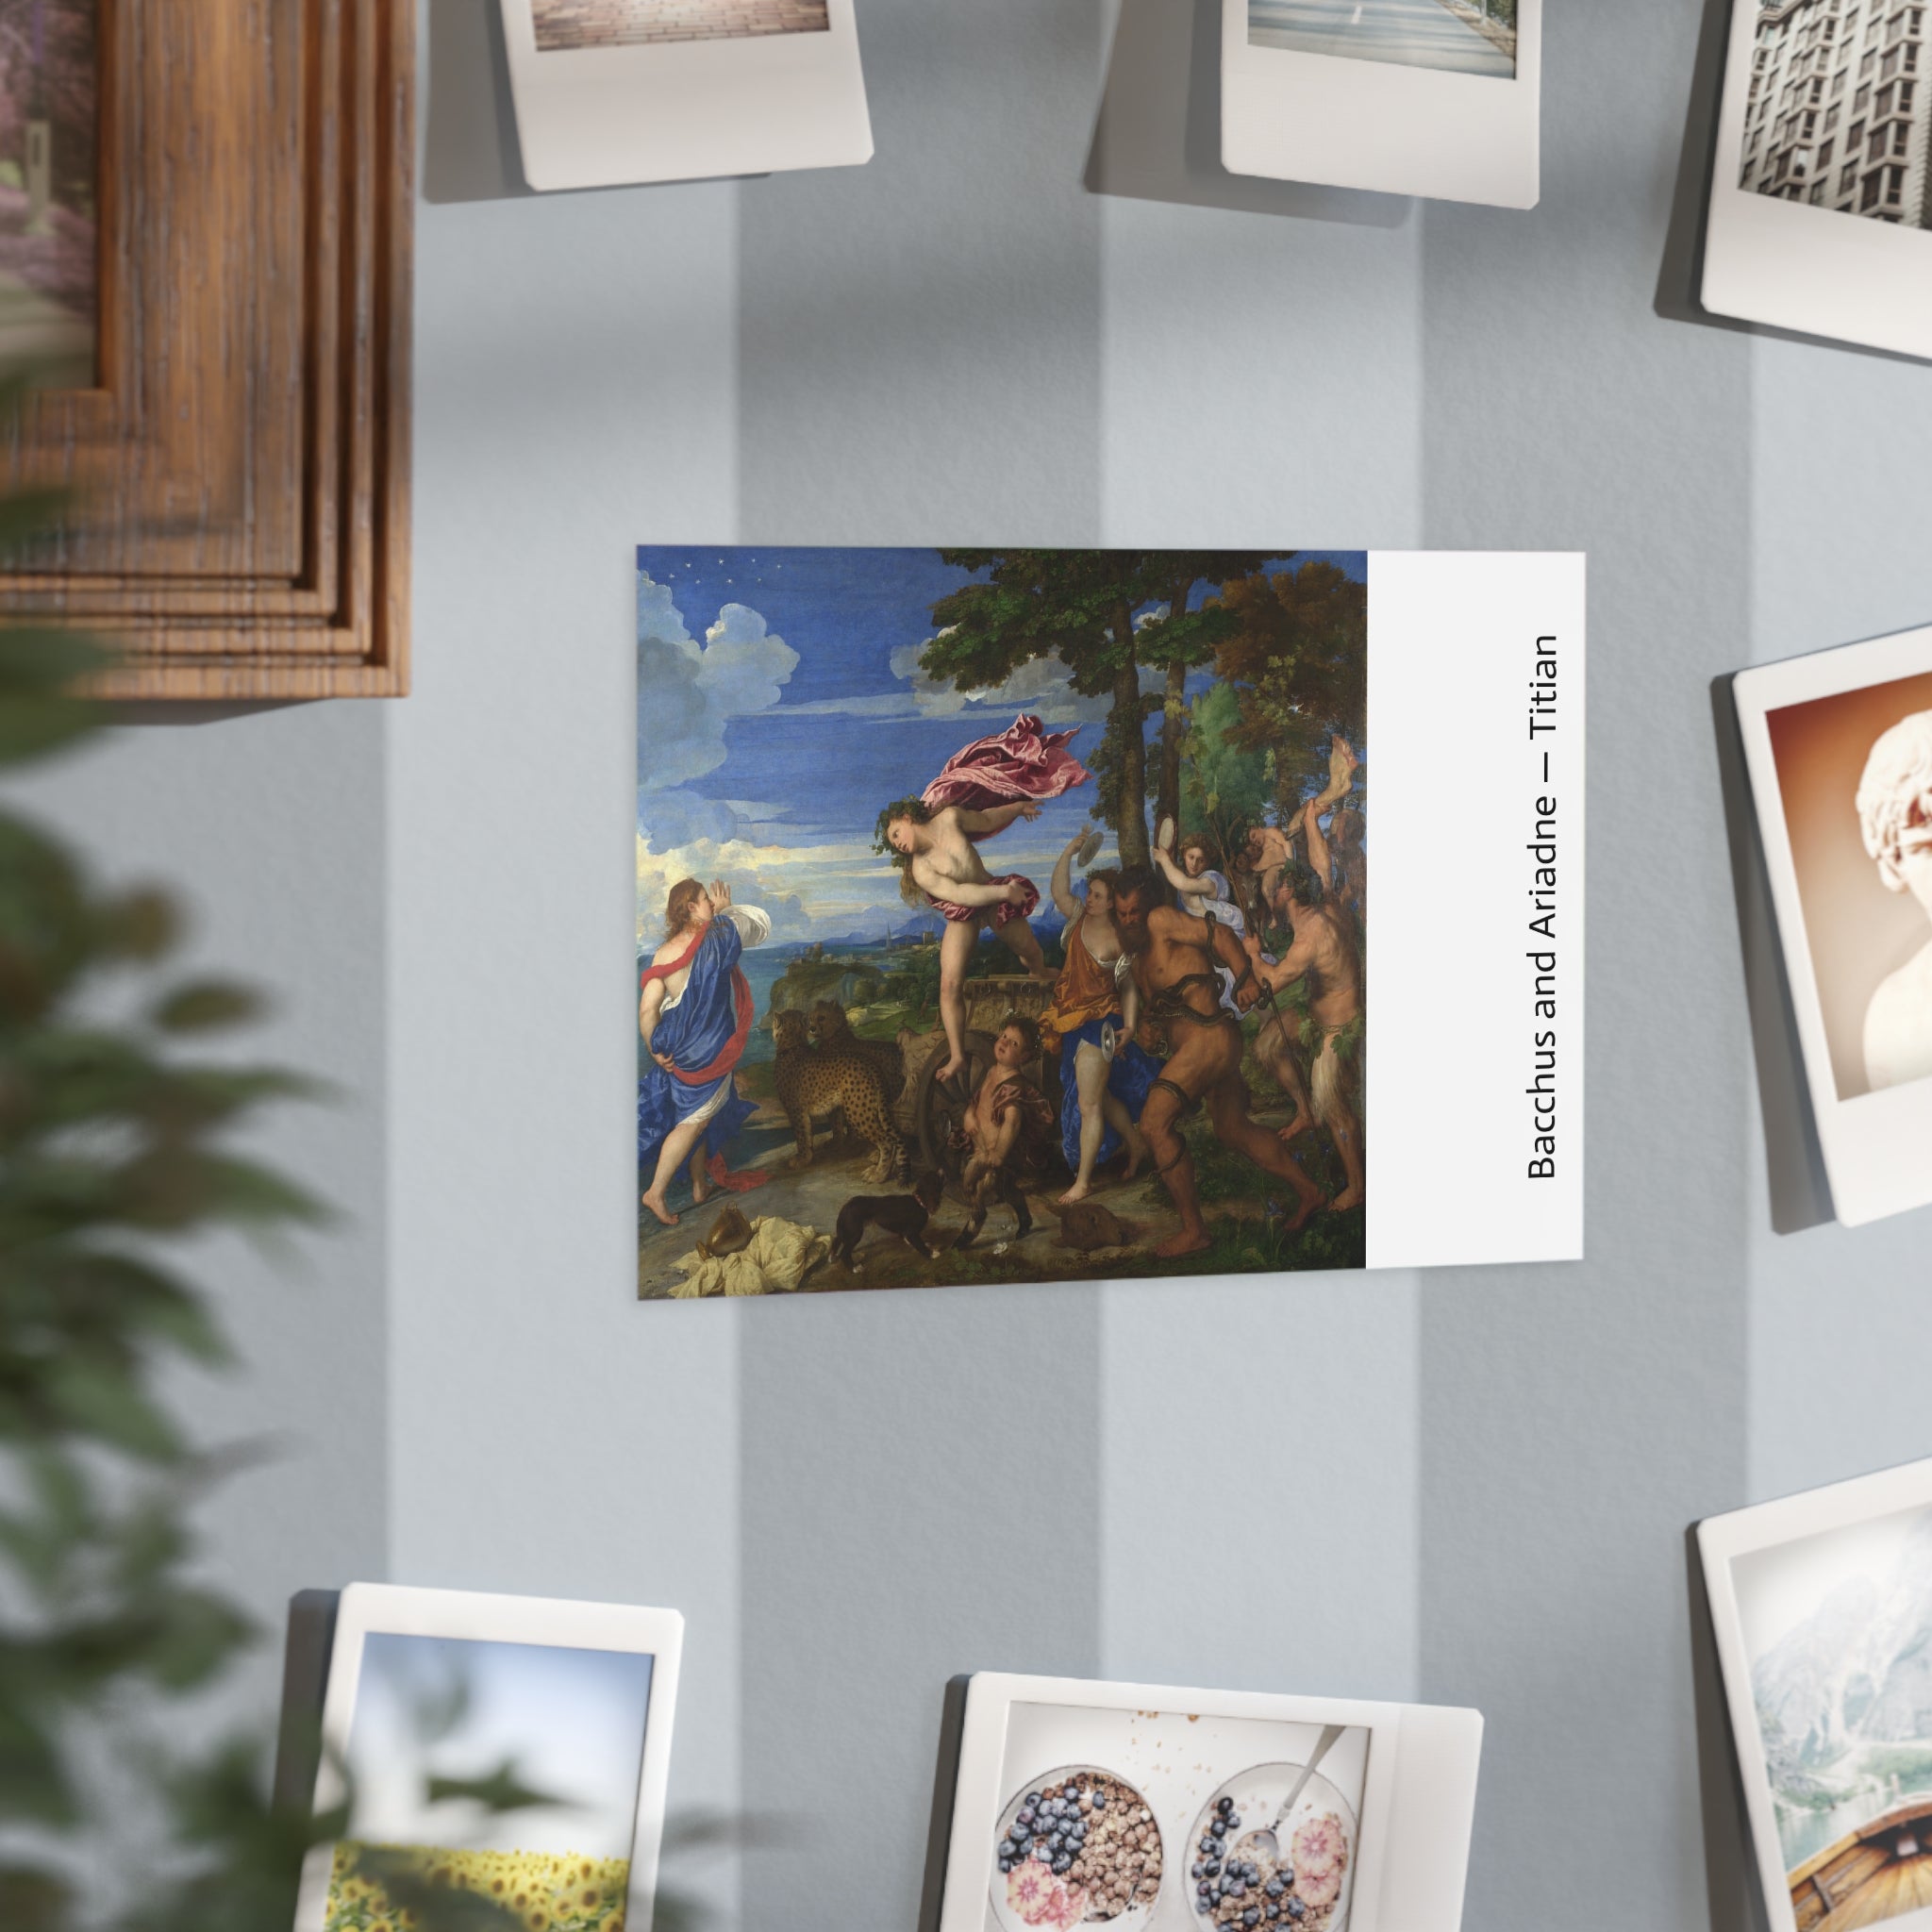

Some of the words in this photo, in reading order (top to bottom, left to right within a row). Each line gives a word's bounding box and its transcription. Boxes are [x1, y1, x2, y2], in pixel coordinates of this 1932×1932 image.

[1528, 636, 1557, 741] Titian
[1526, 795, 1557, 940] Ariadne
[1525, 951, 1557, 1019] and
[1525, 1030, 1557, 1179] Bacchus
